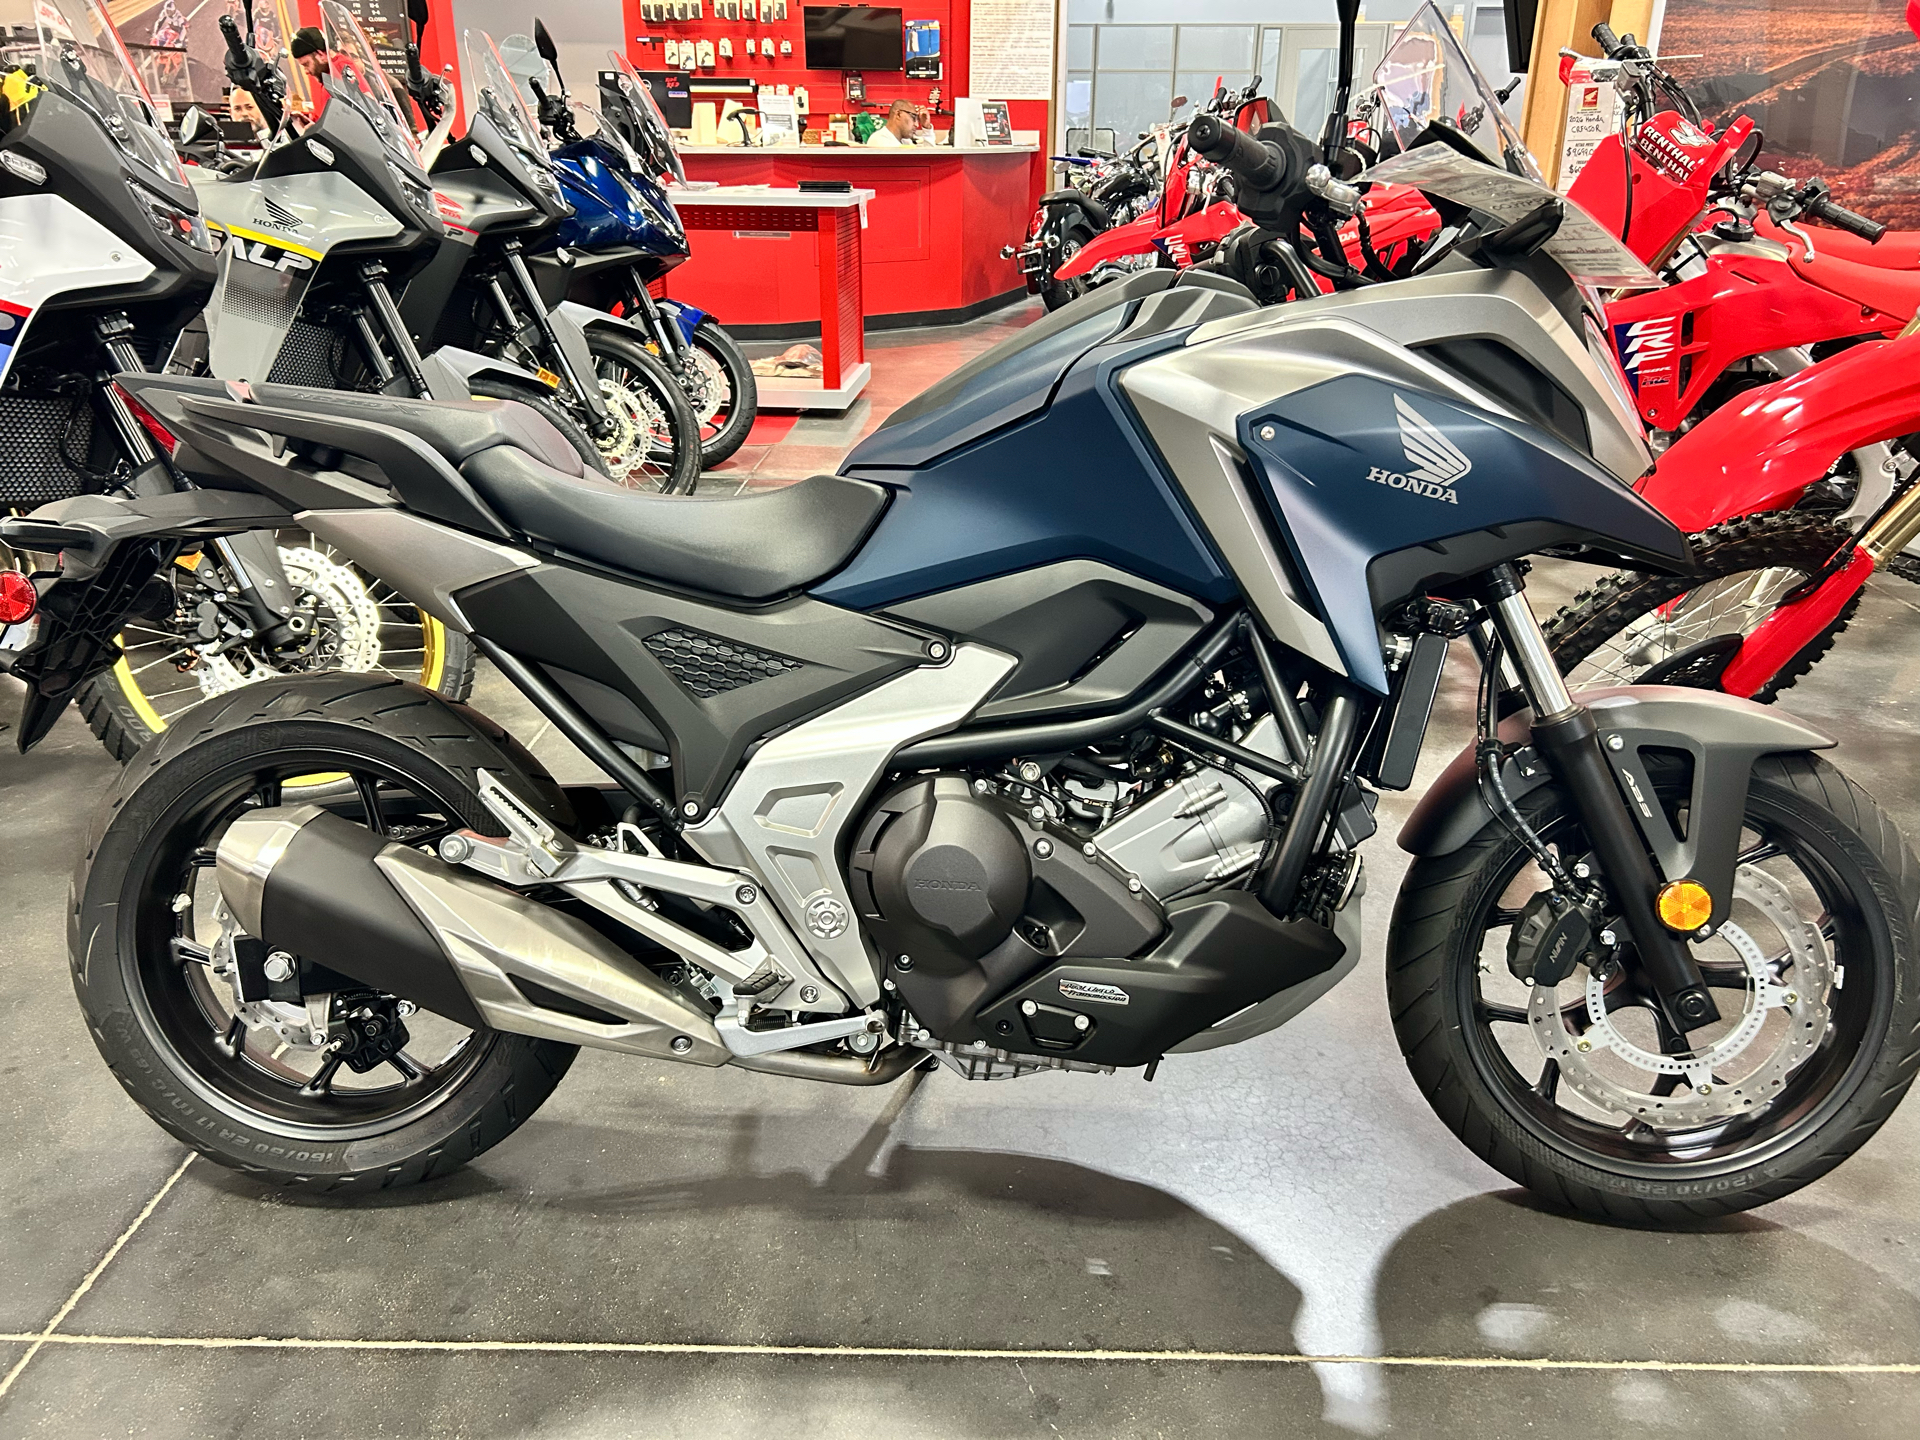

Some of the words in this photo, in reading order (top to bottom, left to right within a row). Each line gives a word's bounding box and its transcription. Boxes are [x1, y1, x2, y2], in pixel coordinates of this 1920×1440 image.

[1643, 125, 1696, 172] RENTHAL
[252, 217, 299, 235] HONDA
[1164, 233, 1188, 263] CRF
[1624, 315, 1676, 371] CRF
[1365, 466, 1459, 505] HONDA
[1621, 767, 1653, 818] ABS
[914, 878, 982, 892] HONDA
[1067, 990, 1127, 1002] Transmission
[254, 1142, 333, 1163] 160/60
